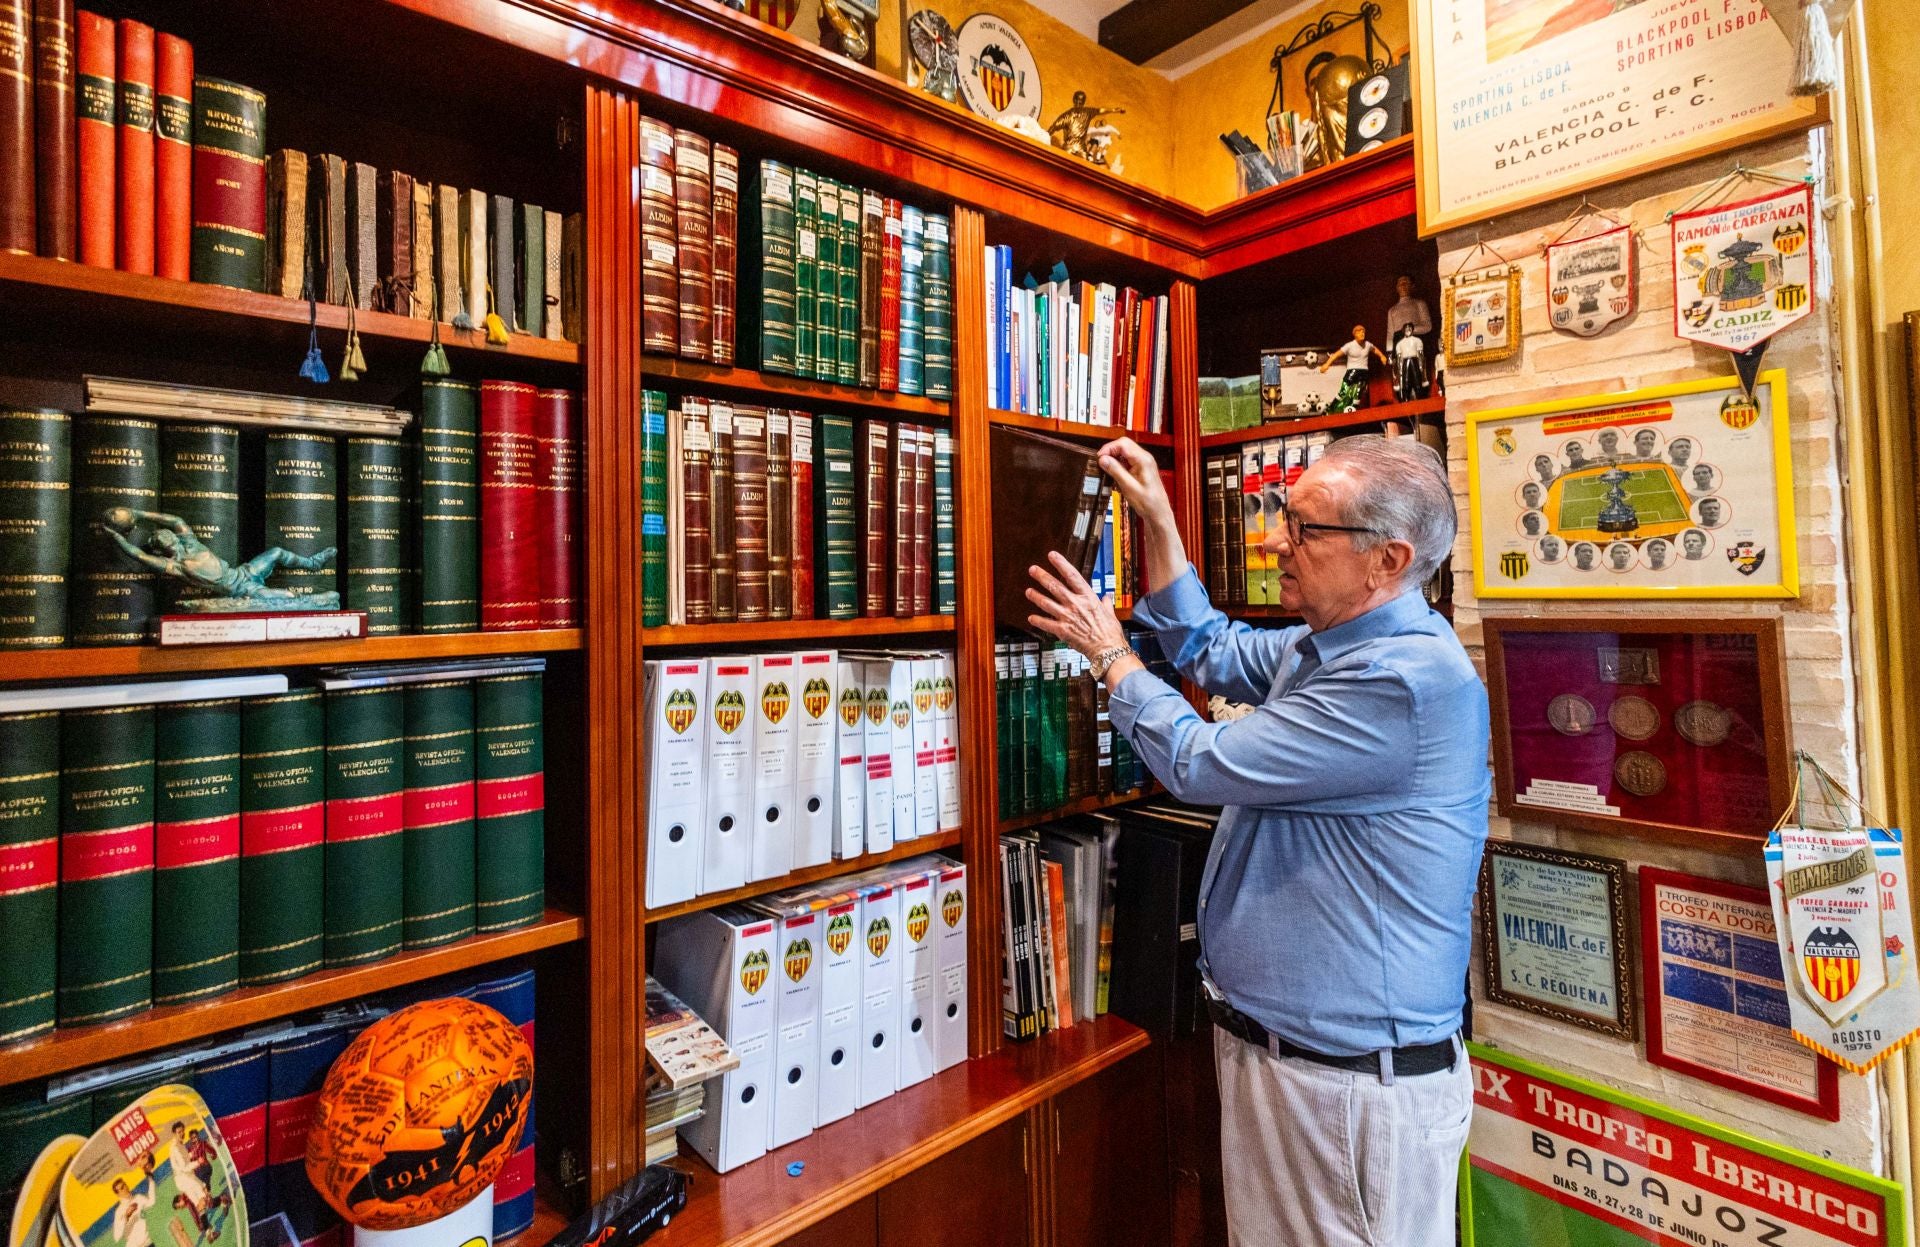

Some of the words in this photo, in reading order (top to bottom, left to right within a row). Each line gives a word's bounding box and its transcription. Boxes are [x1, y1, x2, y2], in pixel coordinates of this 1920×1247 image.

[1617, 8, 1711, 53] BLACKPOOL
[1618, 33, 1695, 72] SPORTING
[1707, 8, 1770, 40] LISBOA
[1453, 82, 1513, 114] SPORTING
[1523, 61, 1572, 88] LISBOA
[1453, 101, 1512, 131] VALENCIA
[1522, 95, 1533, 107] C.
[1540, 87, 1554, 101] de
[1494, 110, 1605, 153] VALENCIA
[1618, 101, 1639, 113] C.
[1653, 86, 1681, 101] de
[1693, 74, 1713, 88] F.
[1664, 130, 1685, 140] LAS
[1731, 102, 1775, 120] NOCHE
[1495, 117, 1640, 170] BLACKPOOL
[1655, 105, 1674, 118] F.
[1690, 94, 1714, 107] C.
[1733, 202, 1774, 218] TROFEO
[1677, 223, 1720, 243] RAMON
[1732, 203, 1805, 230] CARRANZA
[278, 460, 322, 470] REVISTAS
[428, 456, 460, 464] VALENCIA
[275, 469, 311, 478] VALENCIA
[741, 491, 764, 501] ALBUM
[488, 741, 513, 750] REVISTA
[514, 738, 535, 748] OFICIAL
[415, 750, 442, 760] REVISTA
[443, 748, 465, 757] OFICIAL
[491, 748, 520, 757] VALENCIA
[339, 761, 368, 771] REVISTA
[369, 757, 394, 766] OFICIAL
[418, 757, 449, 766] VALENCIA
[202, 773, 233, 784] OFICIAL
[253, 770, 284, 780] REVISTA
[286, 766, 313, 776] OFICIAL
[343, 768, 377, 778] VALENCIA
[257, 778, 296, 788] VALENCIA
[111, 785, 145, 797] OFICIAL
[168, 787, 210, 799] VALENCIA
[75, 799, 120, 811] VALENCIA
[1547, 868, 1556, 876] la
[1557, 869, 1605, 884] VENDIMIA
[1789, 849, 1868, 896] CAMPEONES
[1846, 886, 1865, 895] 1967
[1666, 892, 1708, 907] TROFEO
[1796, 898, 1824, 906] TROFEO
[1827, 900, 1868, 908] CARRANZA
[1659, 900, 1720, 923] COSTA
[1726, 914, 1777, 935] DORA
[1803, 906, 1827, 914] VALENCIA
[1503, 912, 1568, 951] VALENCIA
[1569, 935, 1580, 949] C.
[1582, 938, 1597, 952] de
[1599, 940, 1610, 956] F.
[1807, 946, 1843, 956] VALENCIA
[1511, 969, 1520, 983] S.
[1525, 973, 1536, 987] C.
[1540, 976, 1609, 1006] REQUENA
[1832, 1029, 1882, 1045] AGOSTO
[1843, 1042, 1872, 1051] 1976
[1746, 1065, 1777, 1078] GRAN
[1777, 1072, 1805, 1086] FINAL
[114, 1109, 144, 1141] ANIS
[123, 1130, 156, 1162] MONO
[385, 1157, 440, 1189] 1941
[482, 1094, 519, 1136] 1942
[1528, 1083, 1673, 1161] TROFEO
[1691, 1141, 1879, 1237] IBERICO
[1531, 1130, 1787, 1247] BADAJOZ
[1553, 1174, 1578, 1192] DIAS
[1584, 1186, 1602, 1204] 26,
[1605, 1195, 1619, 1209] 27
[1629, 1204, 1643, 1219] 28
[1649, 1213, 1664, 1229] DE
[1670, 1221, 1707, 1246] JUNIO
